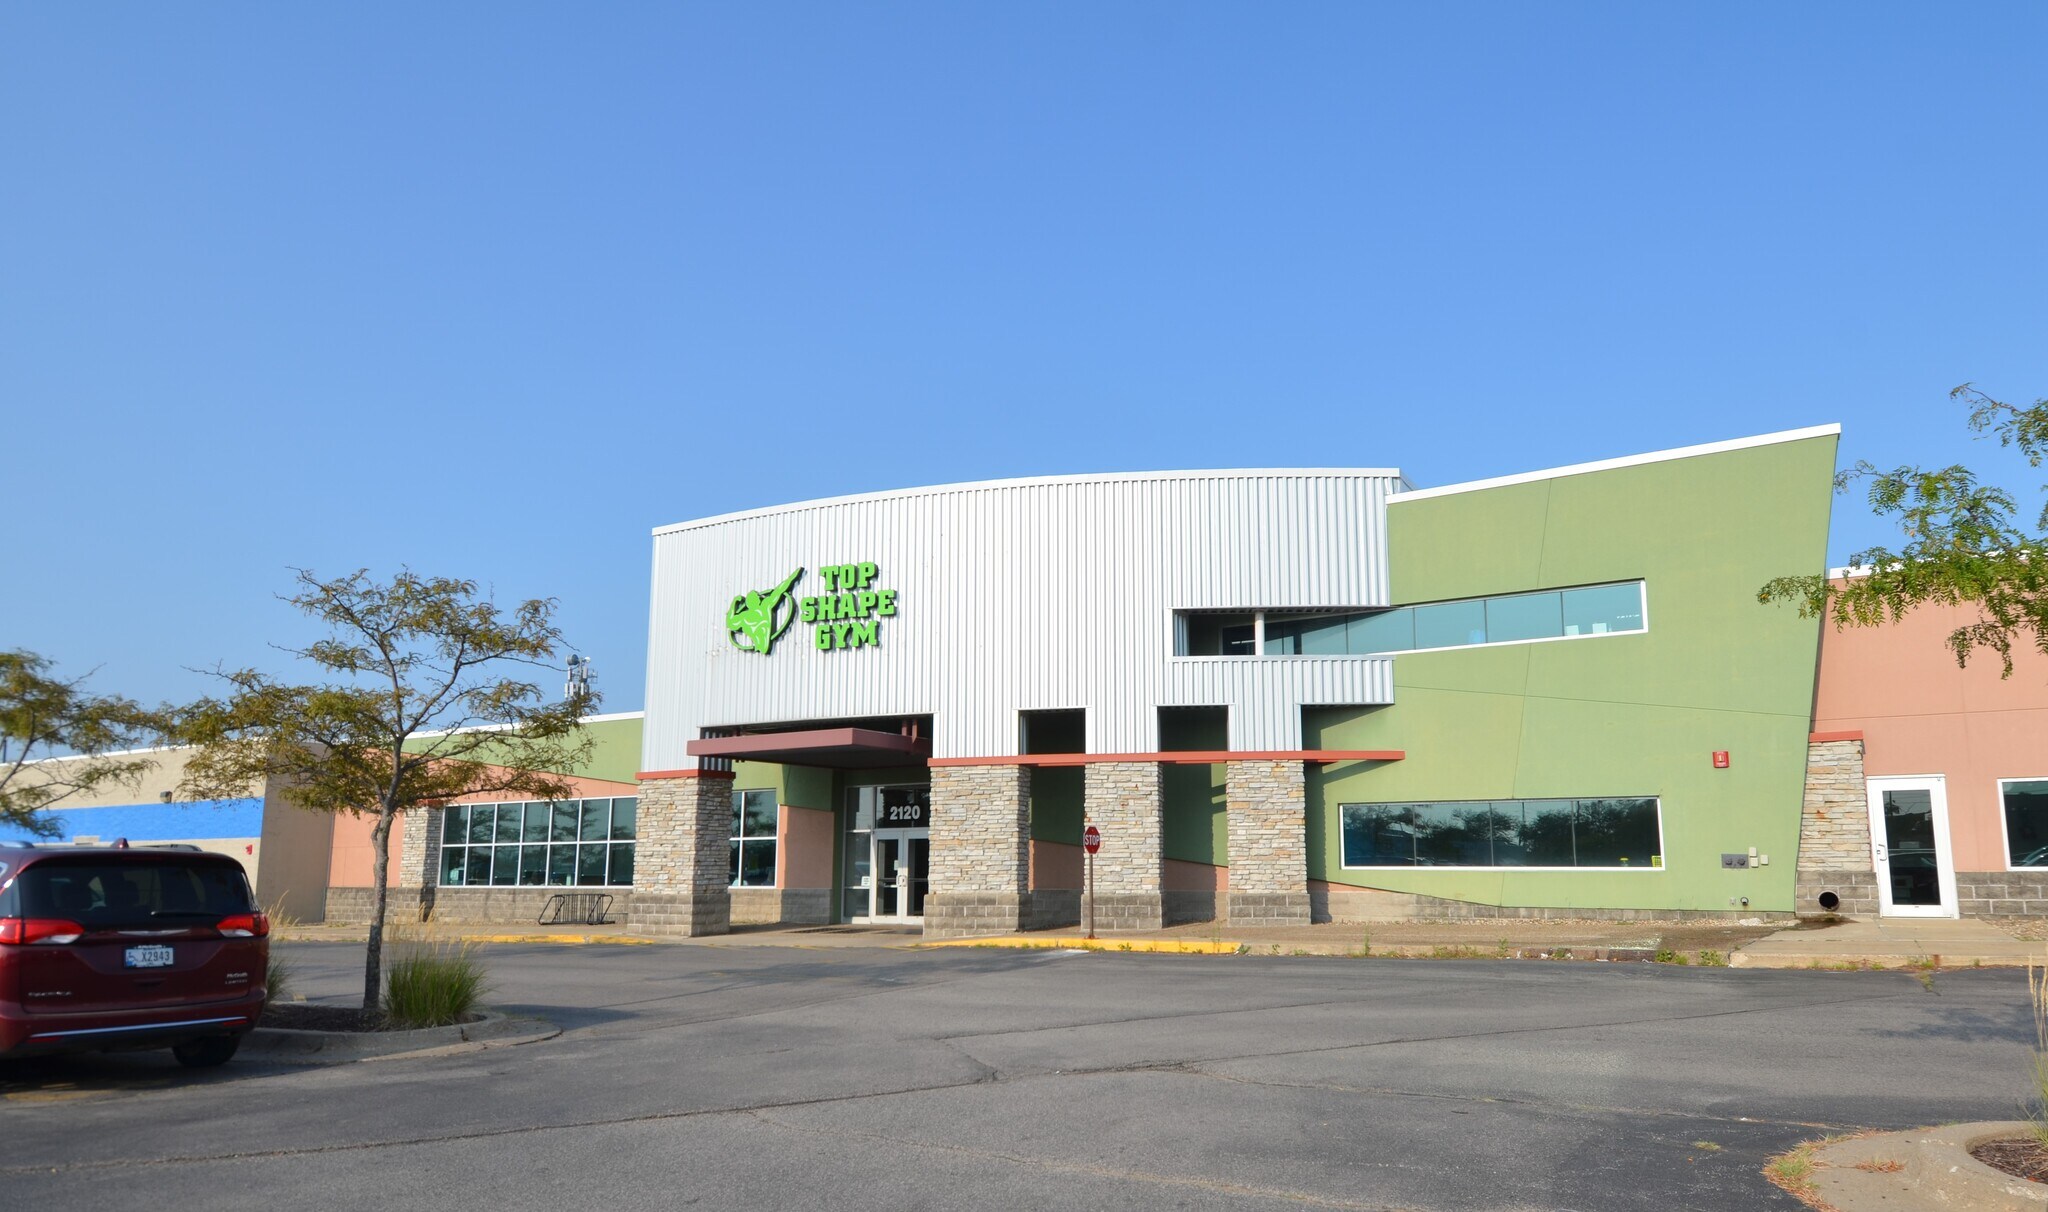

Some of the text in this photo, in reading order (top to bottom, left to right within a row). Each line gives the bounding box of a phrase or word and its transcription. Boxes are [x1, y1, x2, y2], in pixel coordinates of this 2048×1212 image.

[819, 562, 877, 591] TOP
[800, 589, 896, 622] SHAPE
[815, 620, 878, 650] GYM
[889, 804, 921, 820] 2120
[1085, 834, 1100, 846] STOP
[141, 951, 170, 962] X2943
